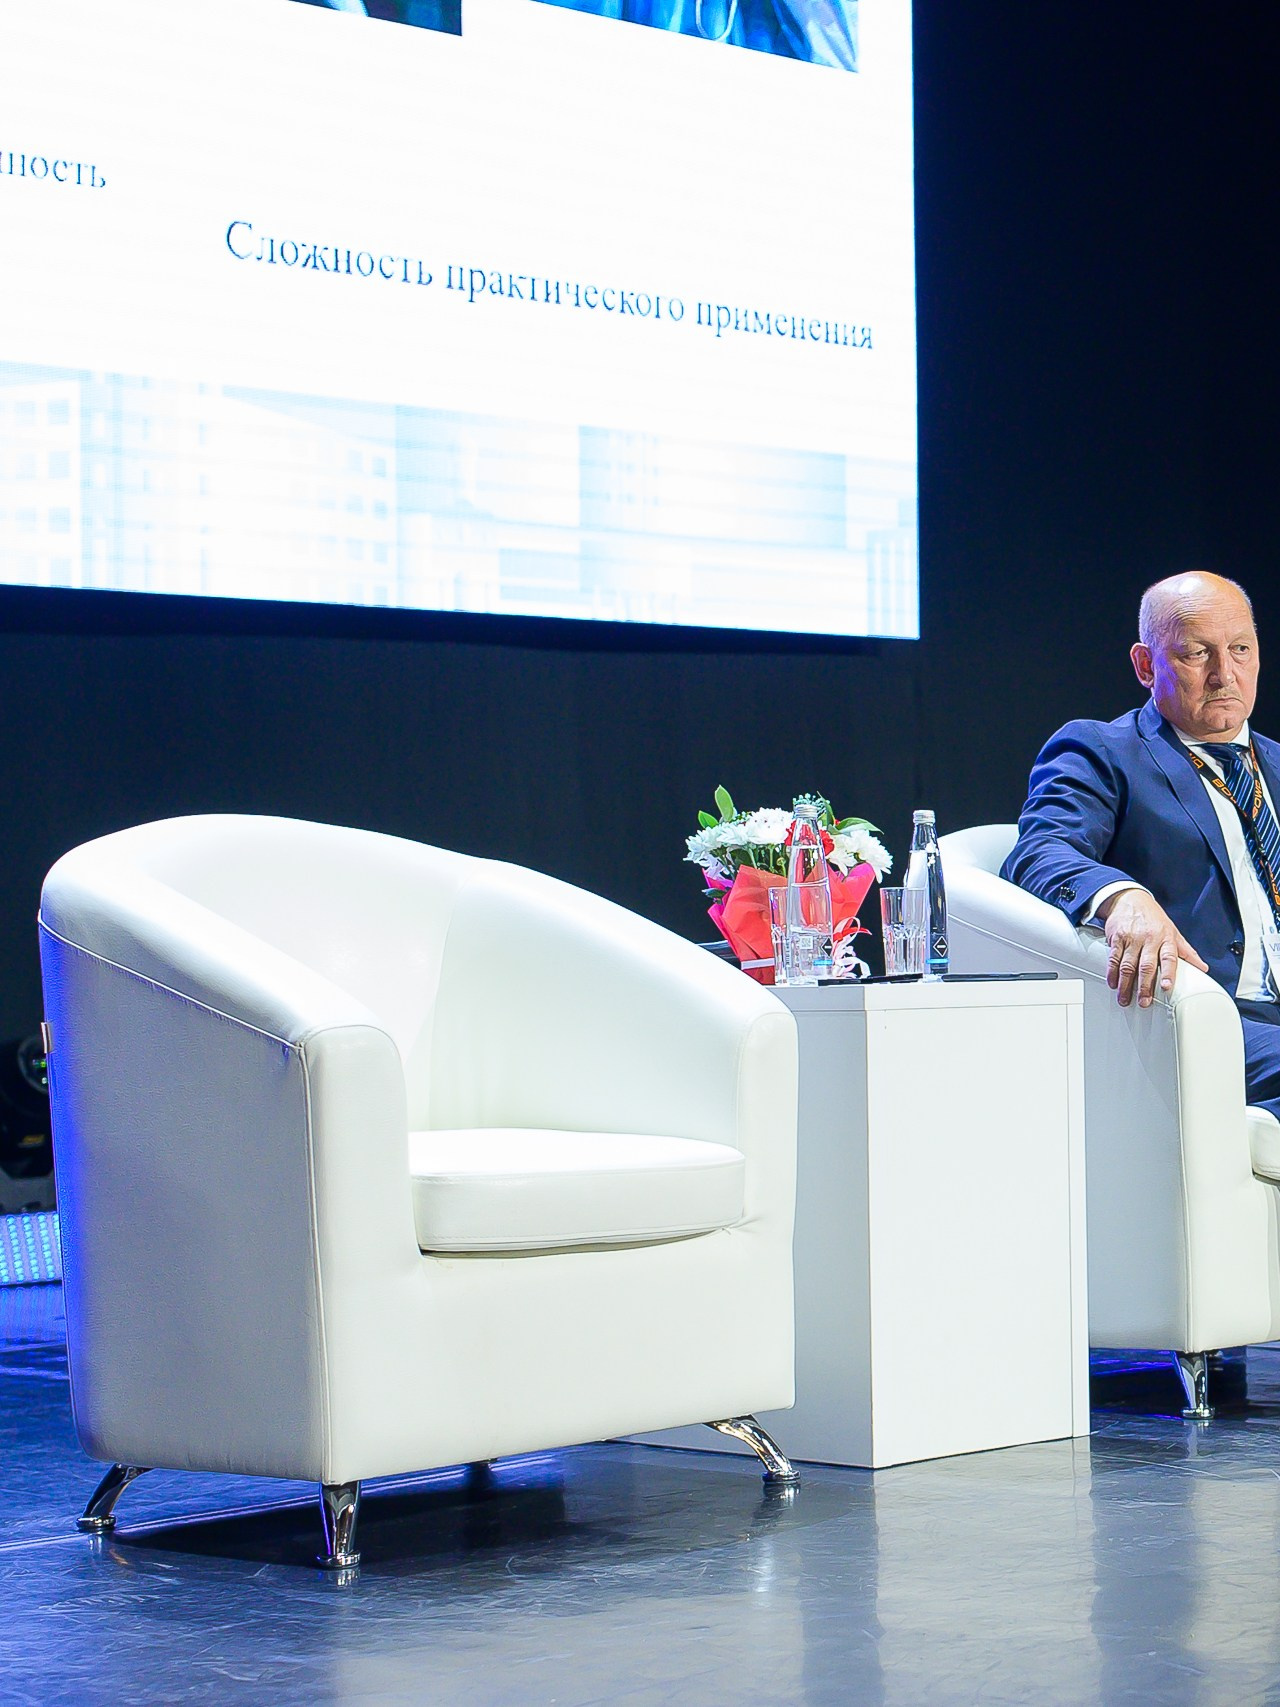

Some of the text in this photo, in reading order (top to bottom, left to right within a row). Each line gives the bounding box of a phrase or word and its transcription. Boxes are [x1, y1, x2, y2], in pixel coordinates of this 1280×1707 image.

[0, 151, 106, 188] ность
[226, 220, 873, 349] Сложность практического применения
